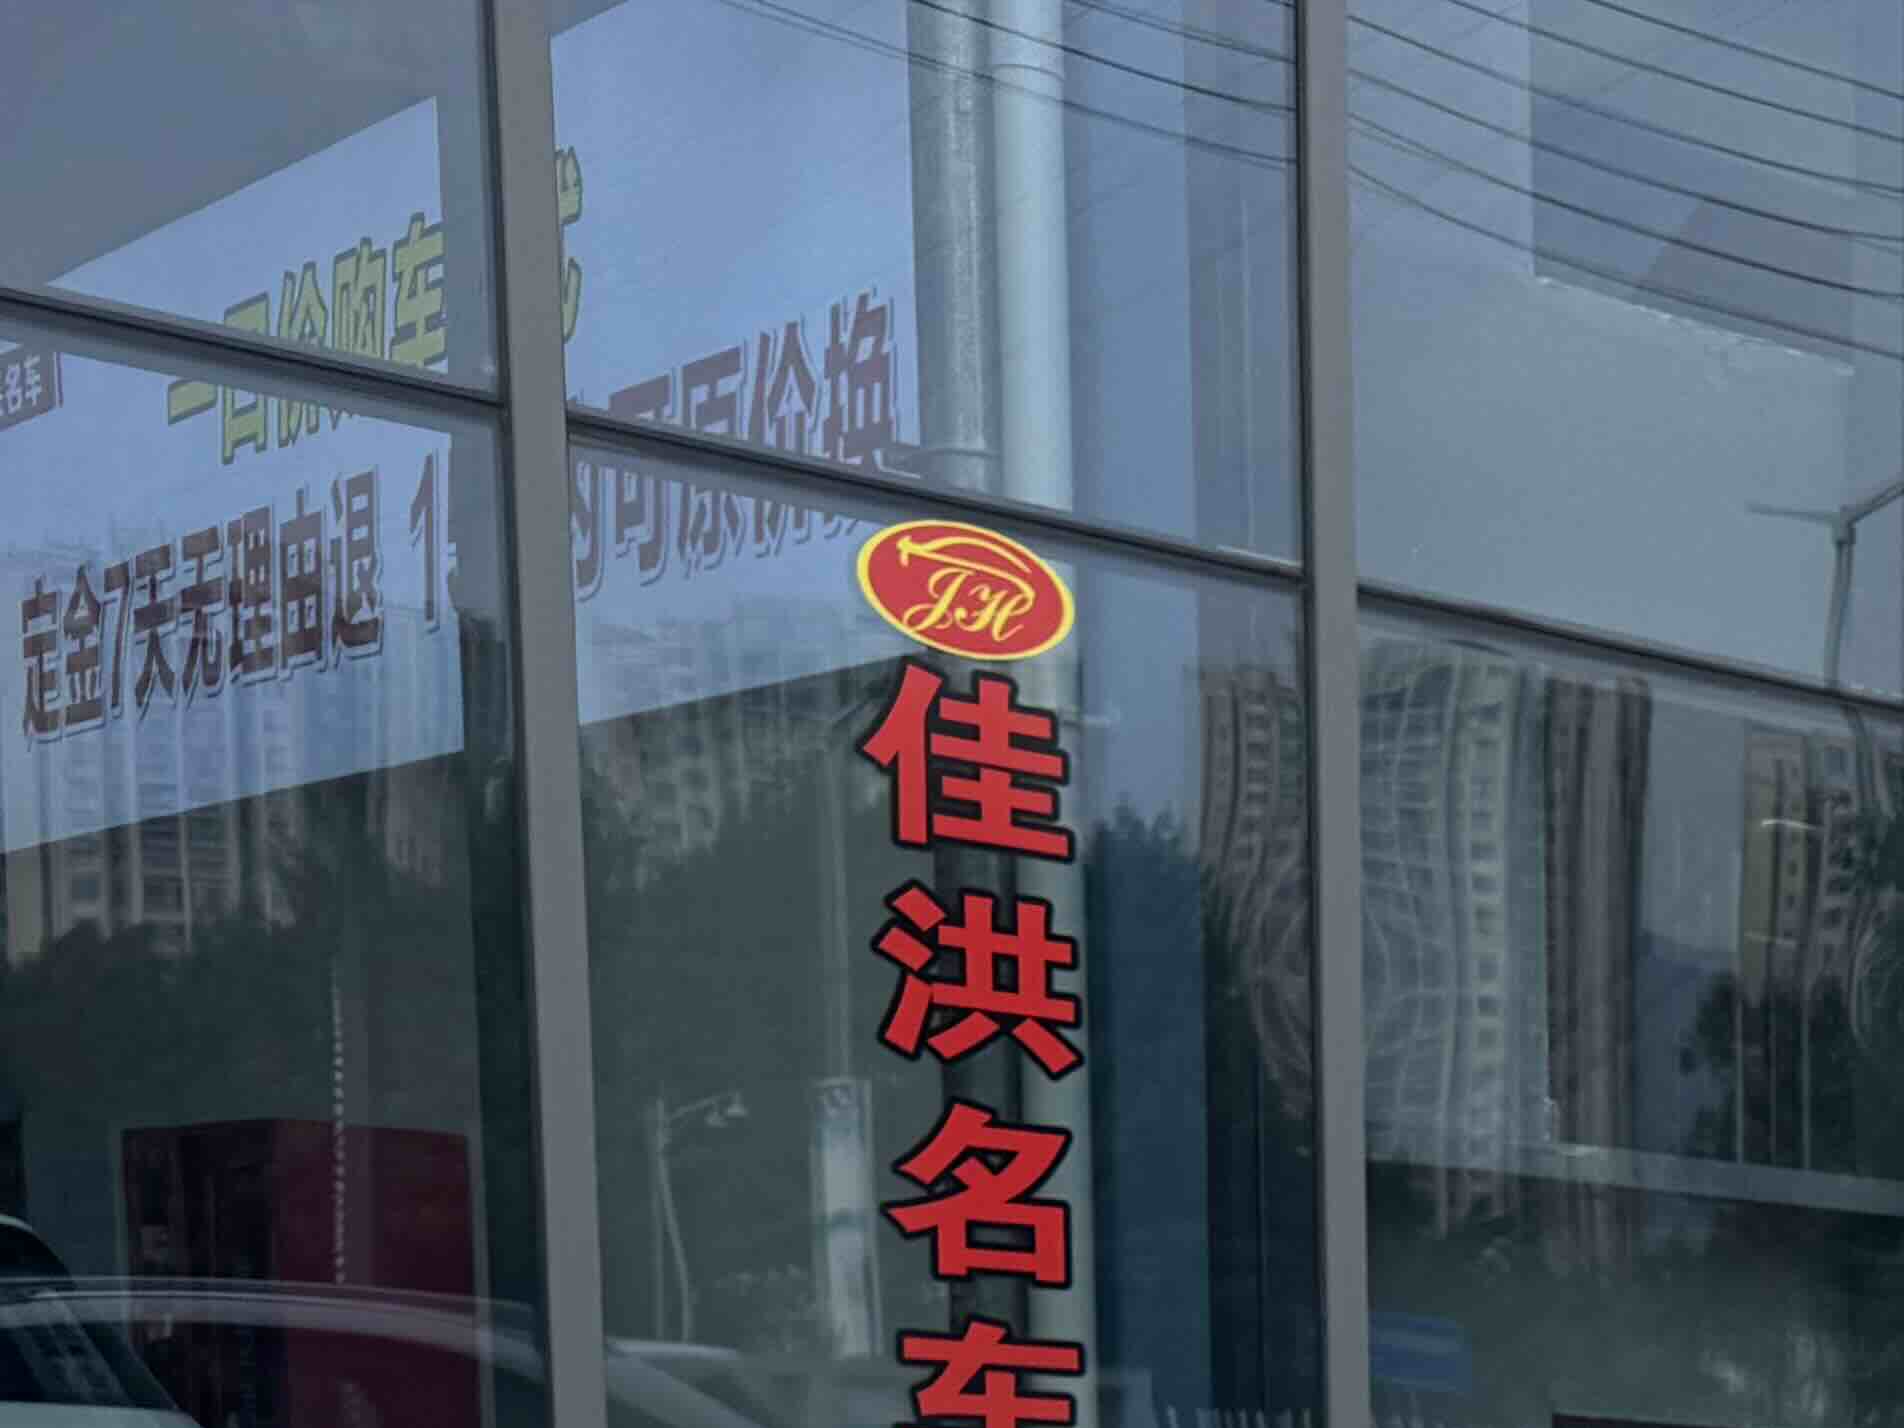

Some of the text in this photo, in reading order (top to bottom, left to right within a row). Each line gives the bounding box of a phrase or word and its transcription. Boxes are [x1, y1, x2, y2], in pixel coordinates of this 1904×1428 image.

[21, 465, 385, 750] 定金7天无理由退
